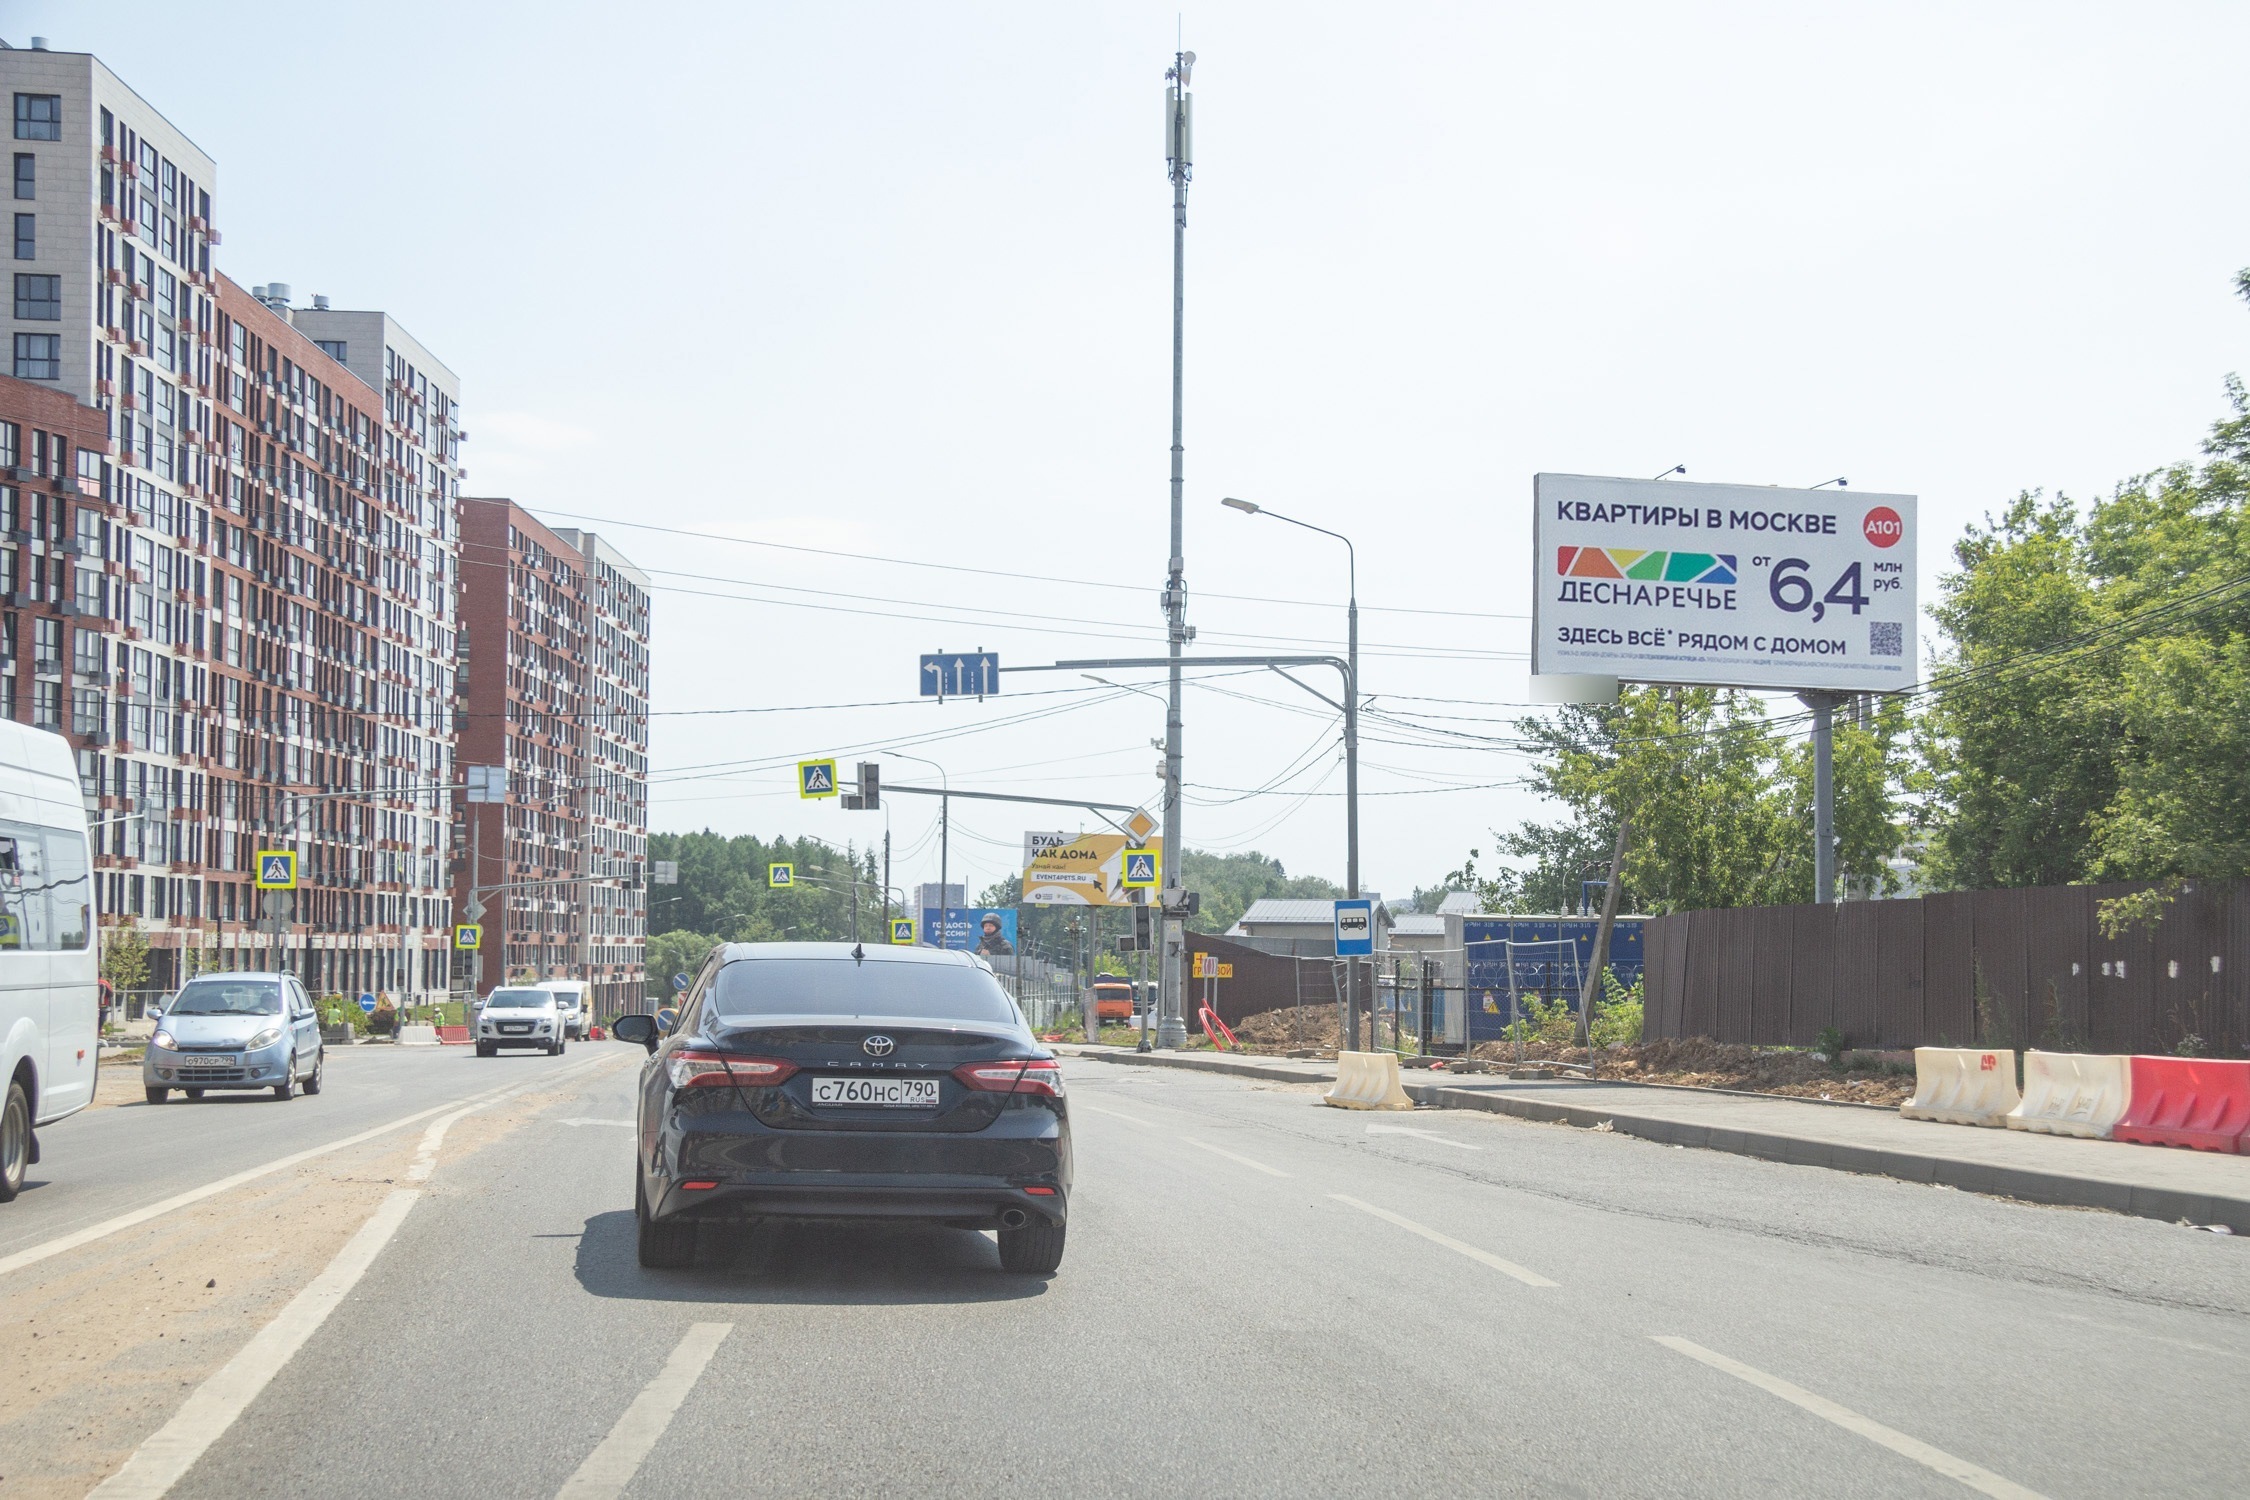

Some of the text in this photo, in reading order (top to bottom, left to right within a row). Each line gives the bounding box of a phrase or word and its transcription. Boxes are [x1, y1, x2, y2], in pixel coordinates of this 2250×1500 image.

[1557, 500, 1837, 535] КВАРТИРЫ В МОСКВЕ
[1865, 520, 1901, 536] А101
[1769, 557, 1870, 624] 6,4
[1873, 576, 1903, 592] руб.
[1557, 580, 1737, 610] ДЕСНАРЕЧЬЕ
[1557, 626, 1623, 645] ЗДЕСЬ
[1678, 632, 1749, 652] РЯДОМ
[1753, 636, 1767, 651] С
[1770, 636, 1846, 656] ДОМОМ
[1032, 835, 1064, 847] БУДЬ
[1031, 848, 1097, 860] КАК ДОМА
[932, 921, 973, 929] ГОДОСТЬ
[1193, 964, 1232, 976] ГРВОЙ
[827, 1061, 929, 1069] CAMRY
[819, 1081, 935, 1102] С760НС 790
